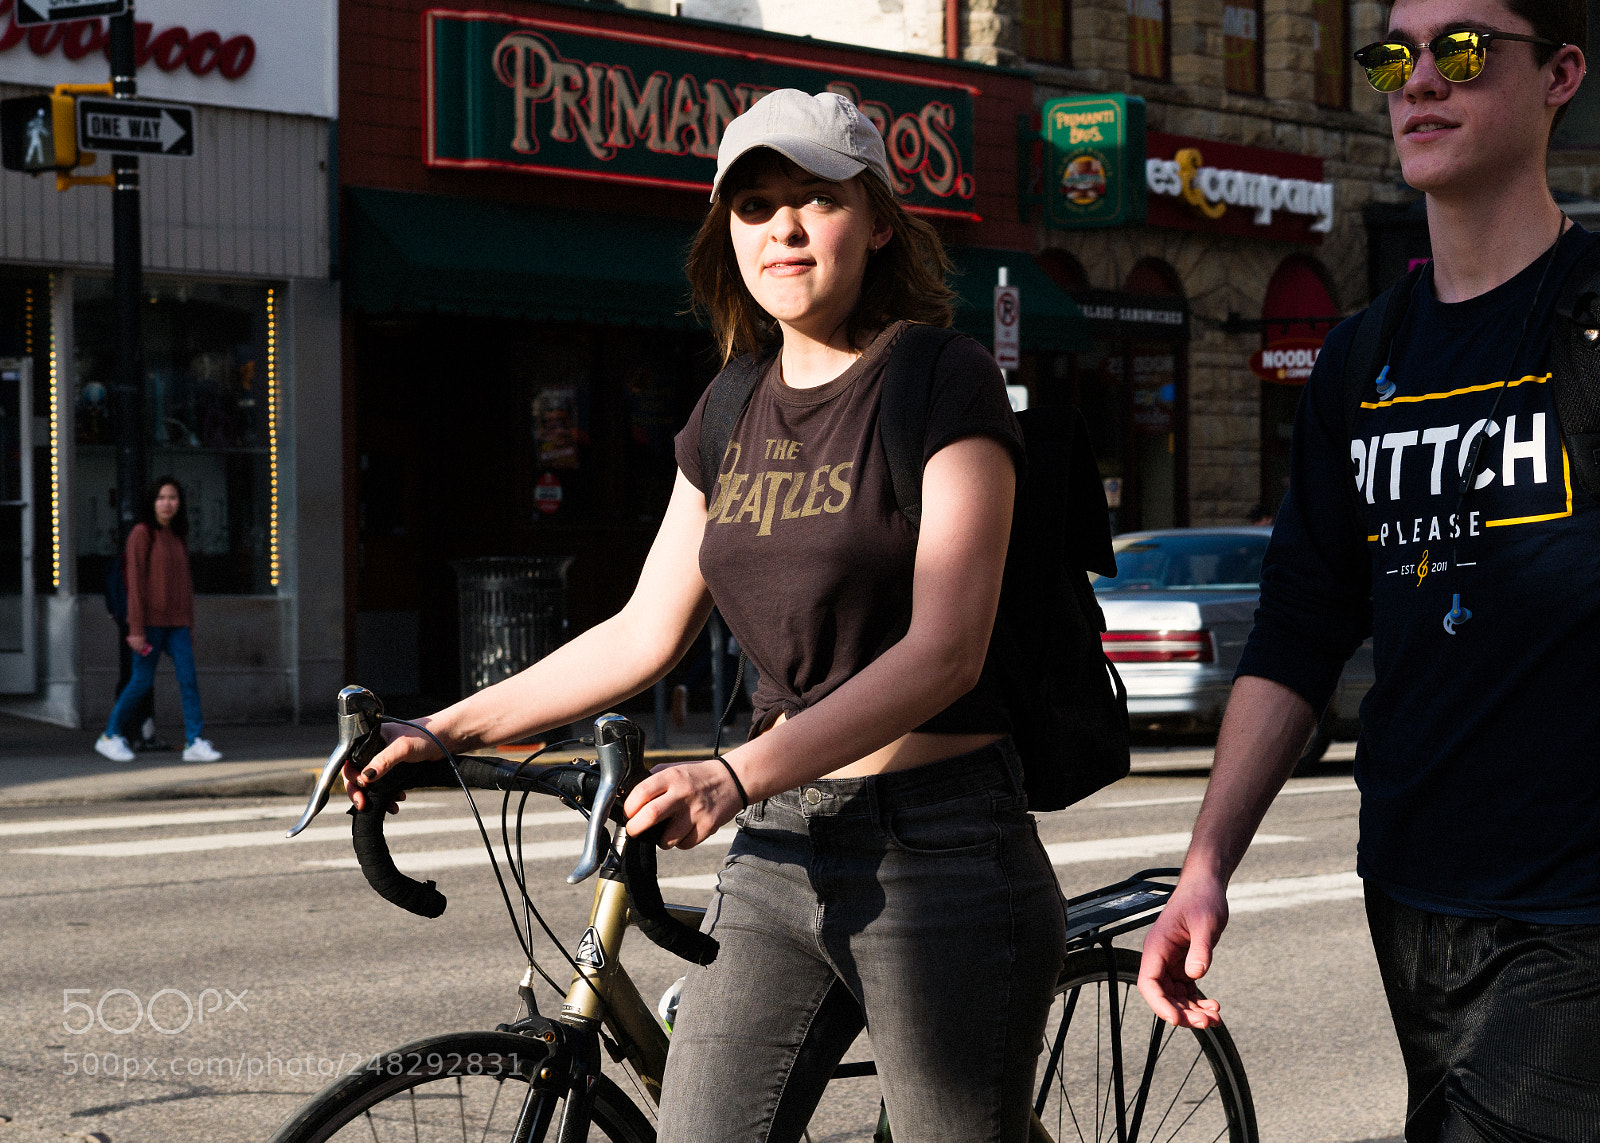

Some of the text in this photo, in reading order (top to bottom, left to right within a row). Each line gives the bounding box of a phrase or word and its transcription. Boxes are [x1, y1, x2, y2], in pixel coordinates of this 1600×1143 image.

[91, 115, 161, 139] ONE WAY
[1262, 348, 1323, 369] NOODL
[764, 438, 804, 461] THE
[1380, 510, 1481, 546] PLEASE
[1400, 561, 1449, 576] EST. 2011
